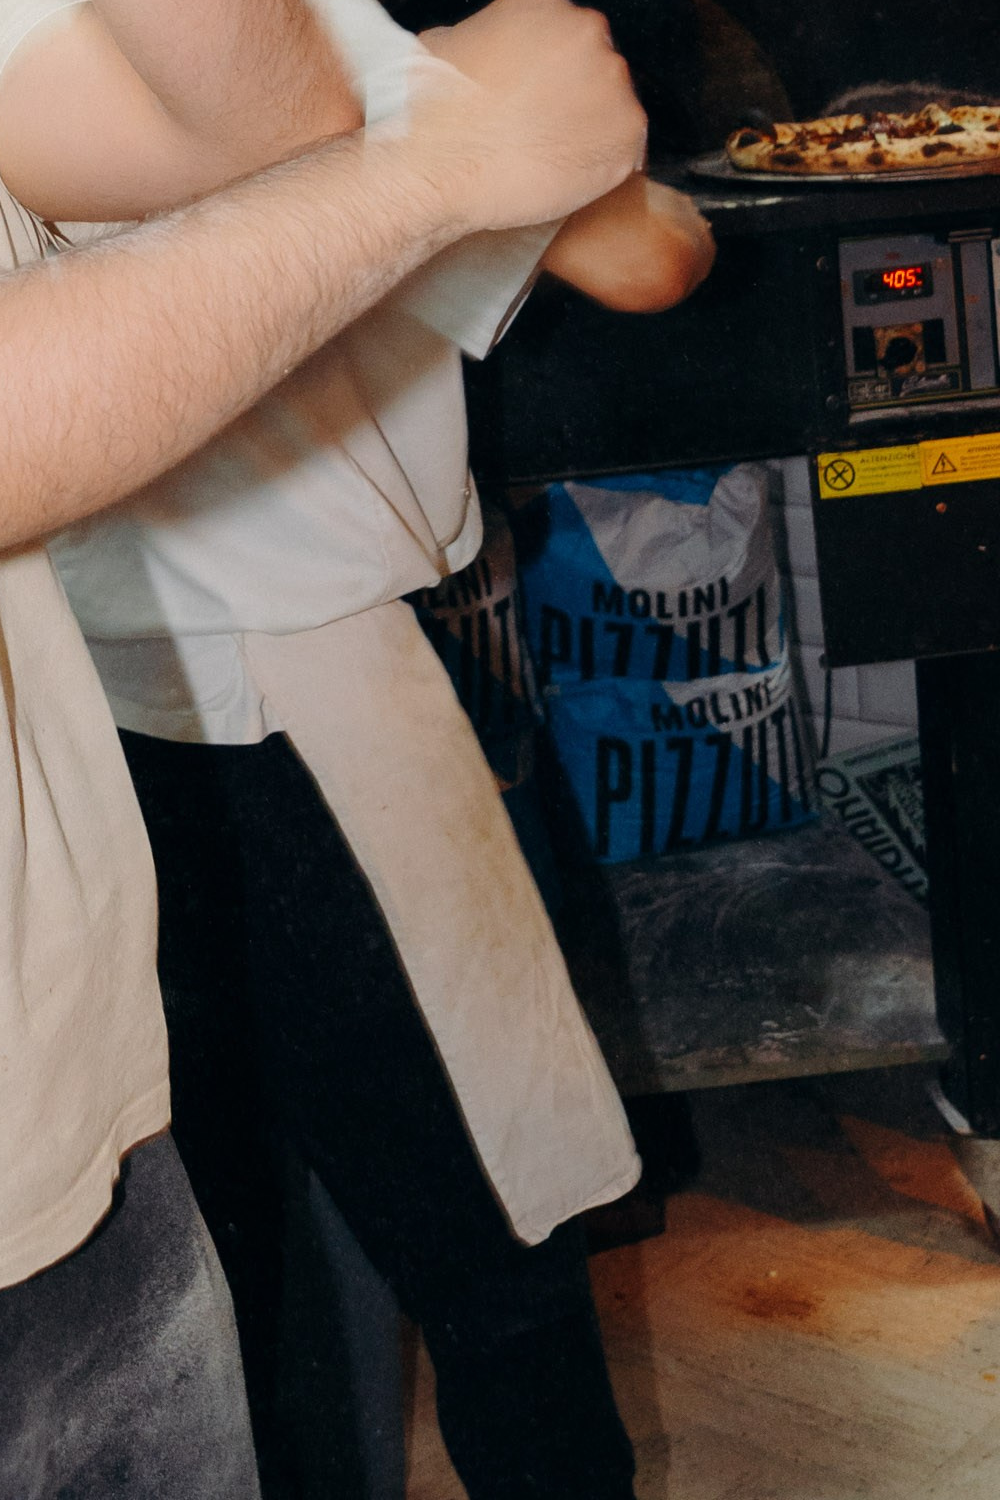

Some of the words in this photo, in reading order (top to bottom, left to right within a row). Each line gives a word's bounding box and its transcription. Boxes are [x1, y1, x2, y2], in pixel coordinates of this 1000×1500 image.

[882, 268, 917, 289] 405
[592, 576, 730, 620] MOLINI
[540, 582, 771, 682] PIZZUTI
